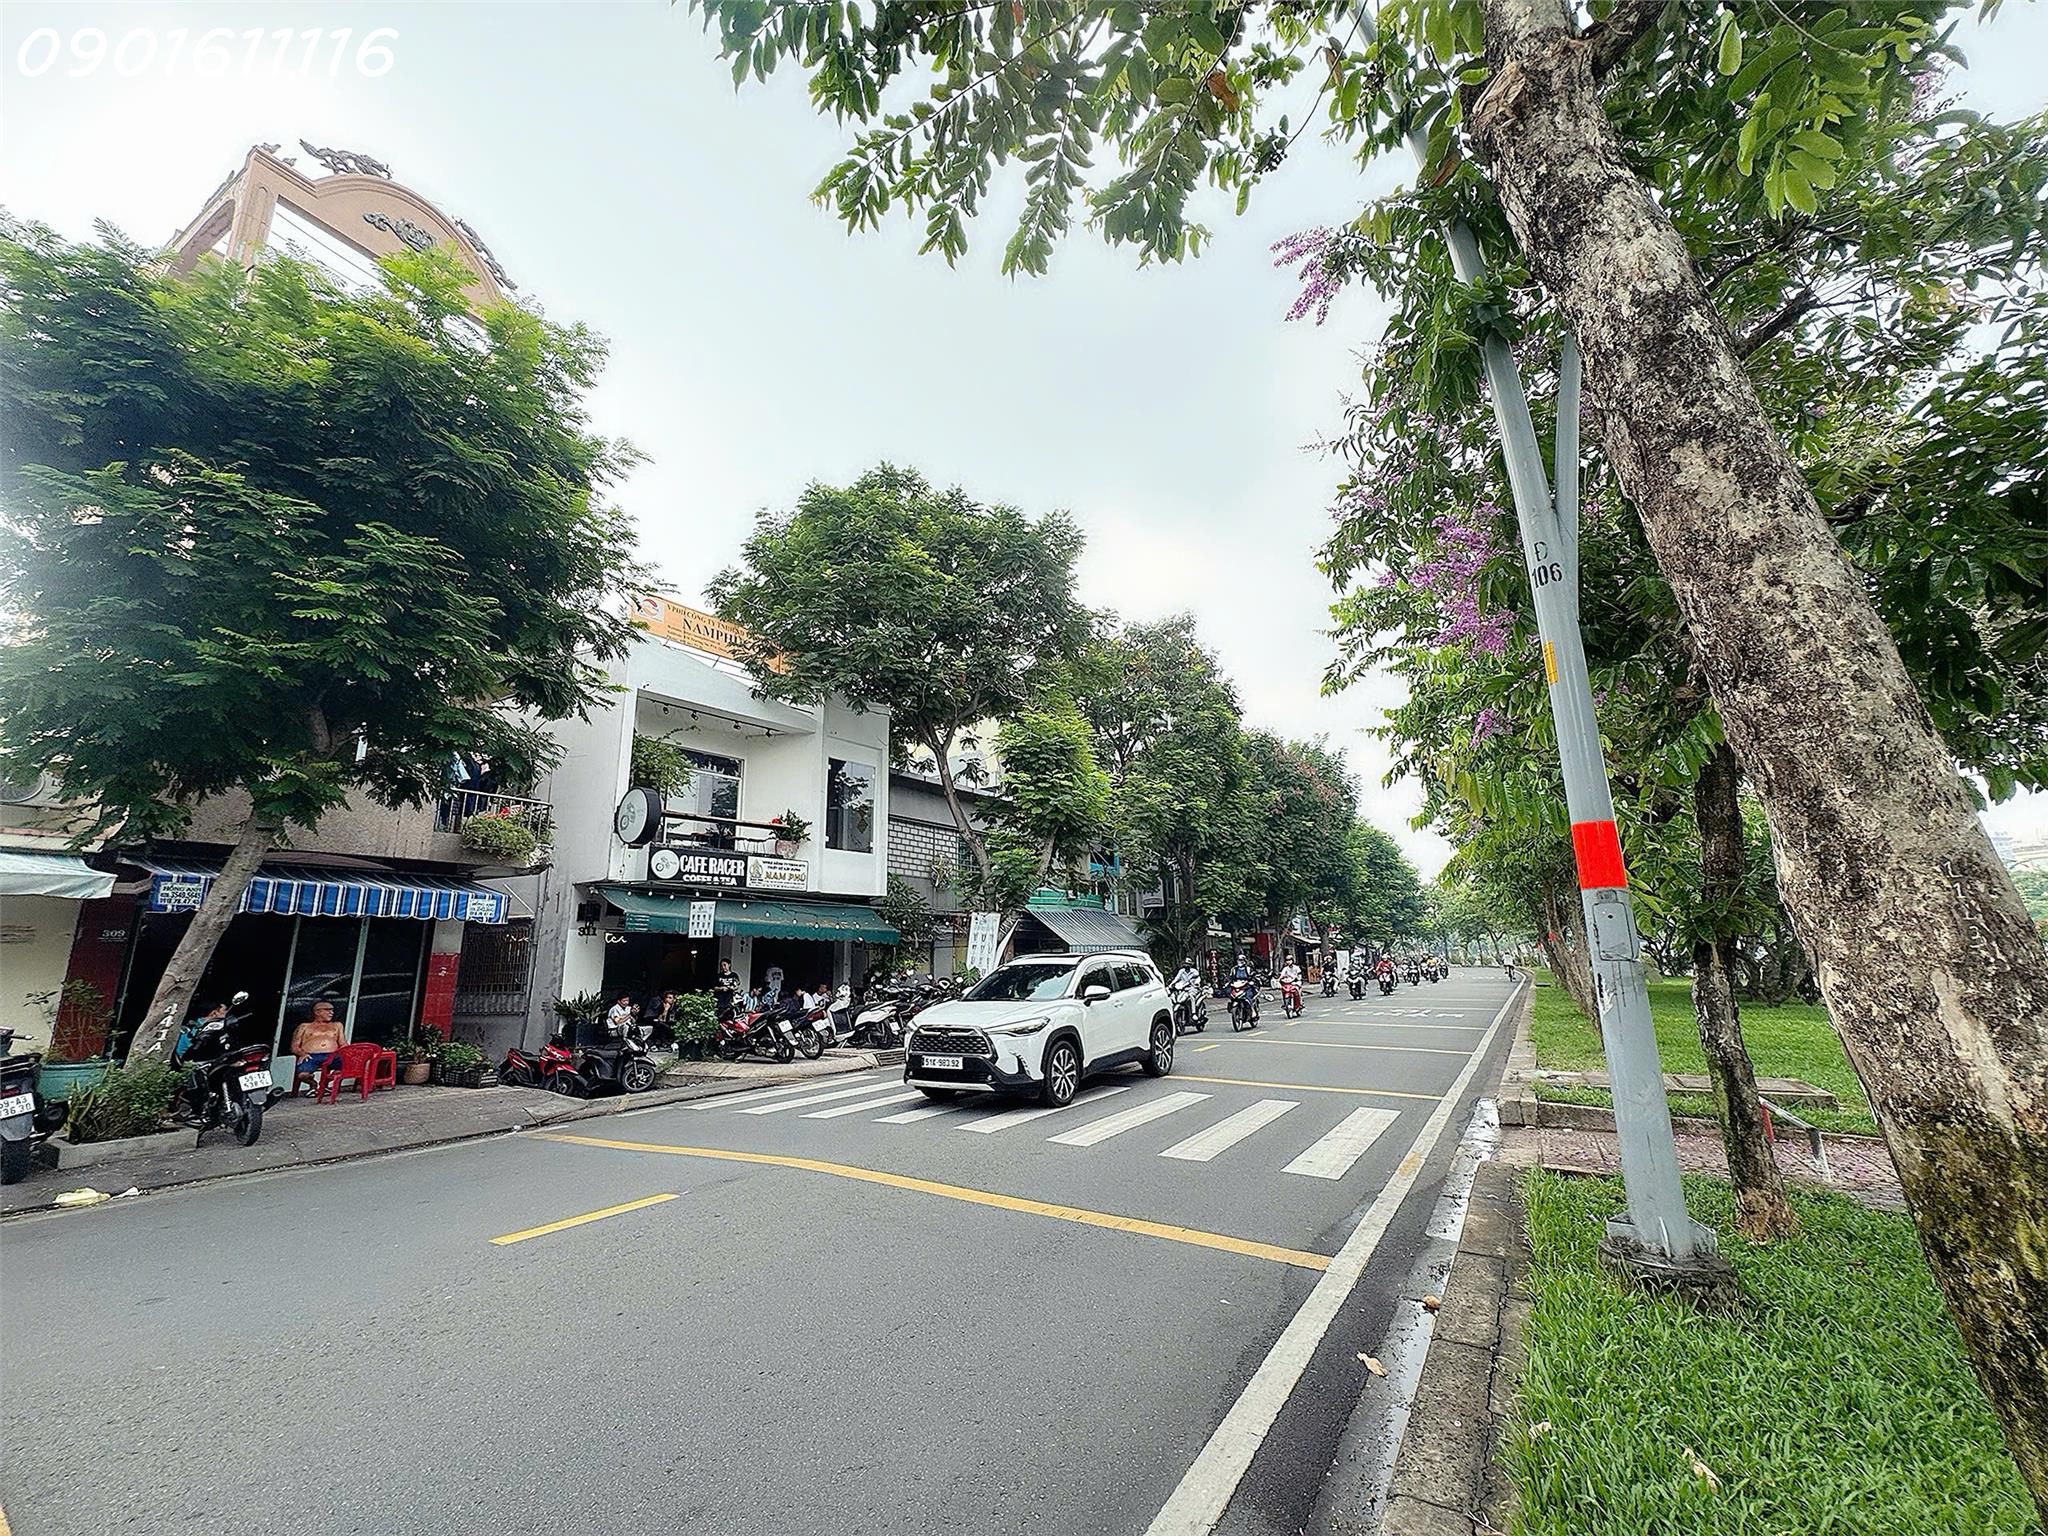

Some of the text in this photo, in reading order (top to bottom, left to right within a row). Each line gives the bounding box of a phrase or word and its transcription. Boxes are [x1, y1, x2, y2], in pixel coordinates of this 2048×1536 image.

[1532, 562, 1562, 588] 106
[680, 855, 745, 876] CAFE RACER
[102, 929, 126, 937] 309
